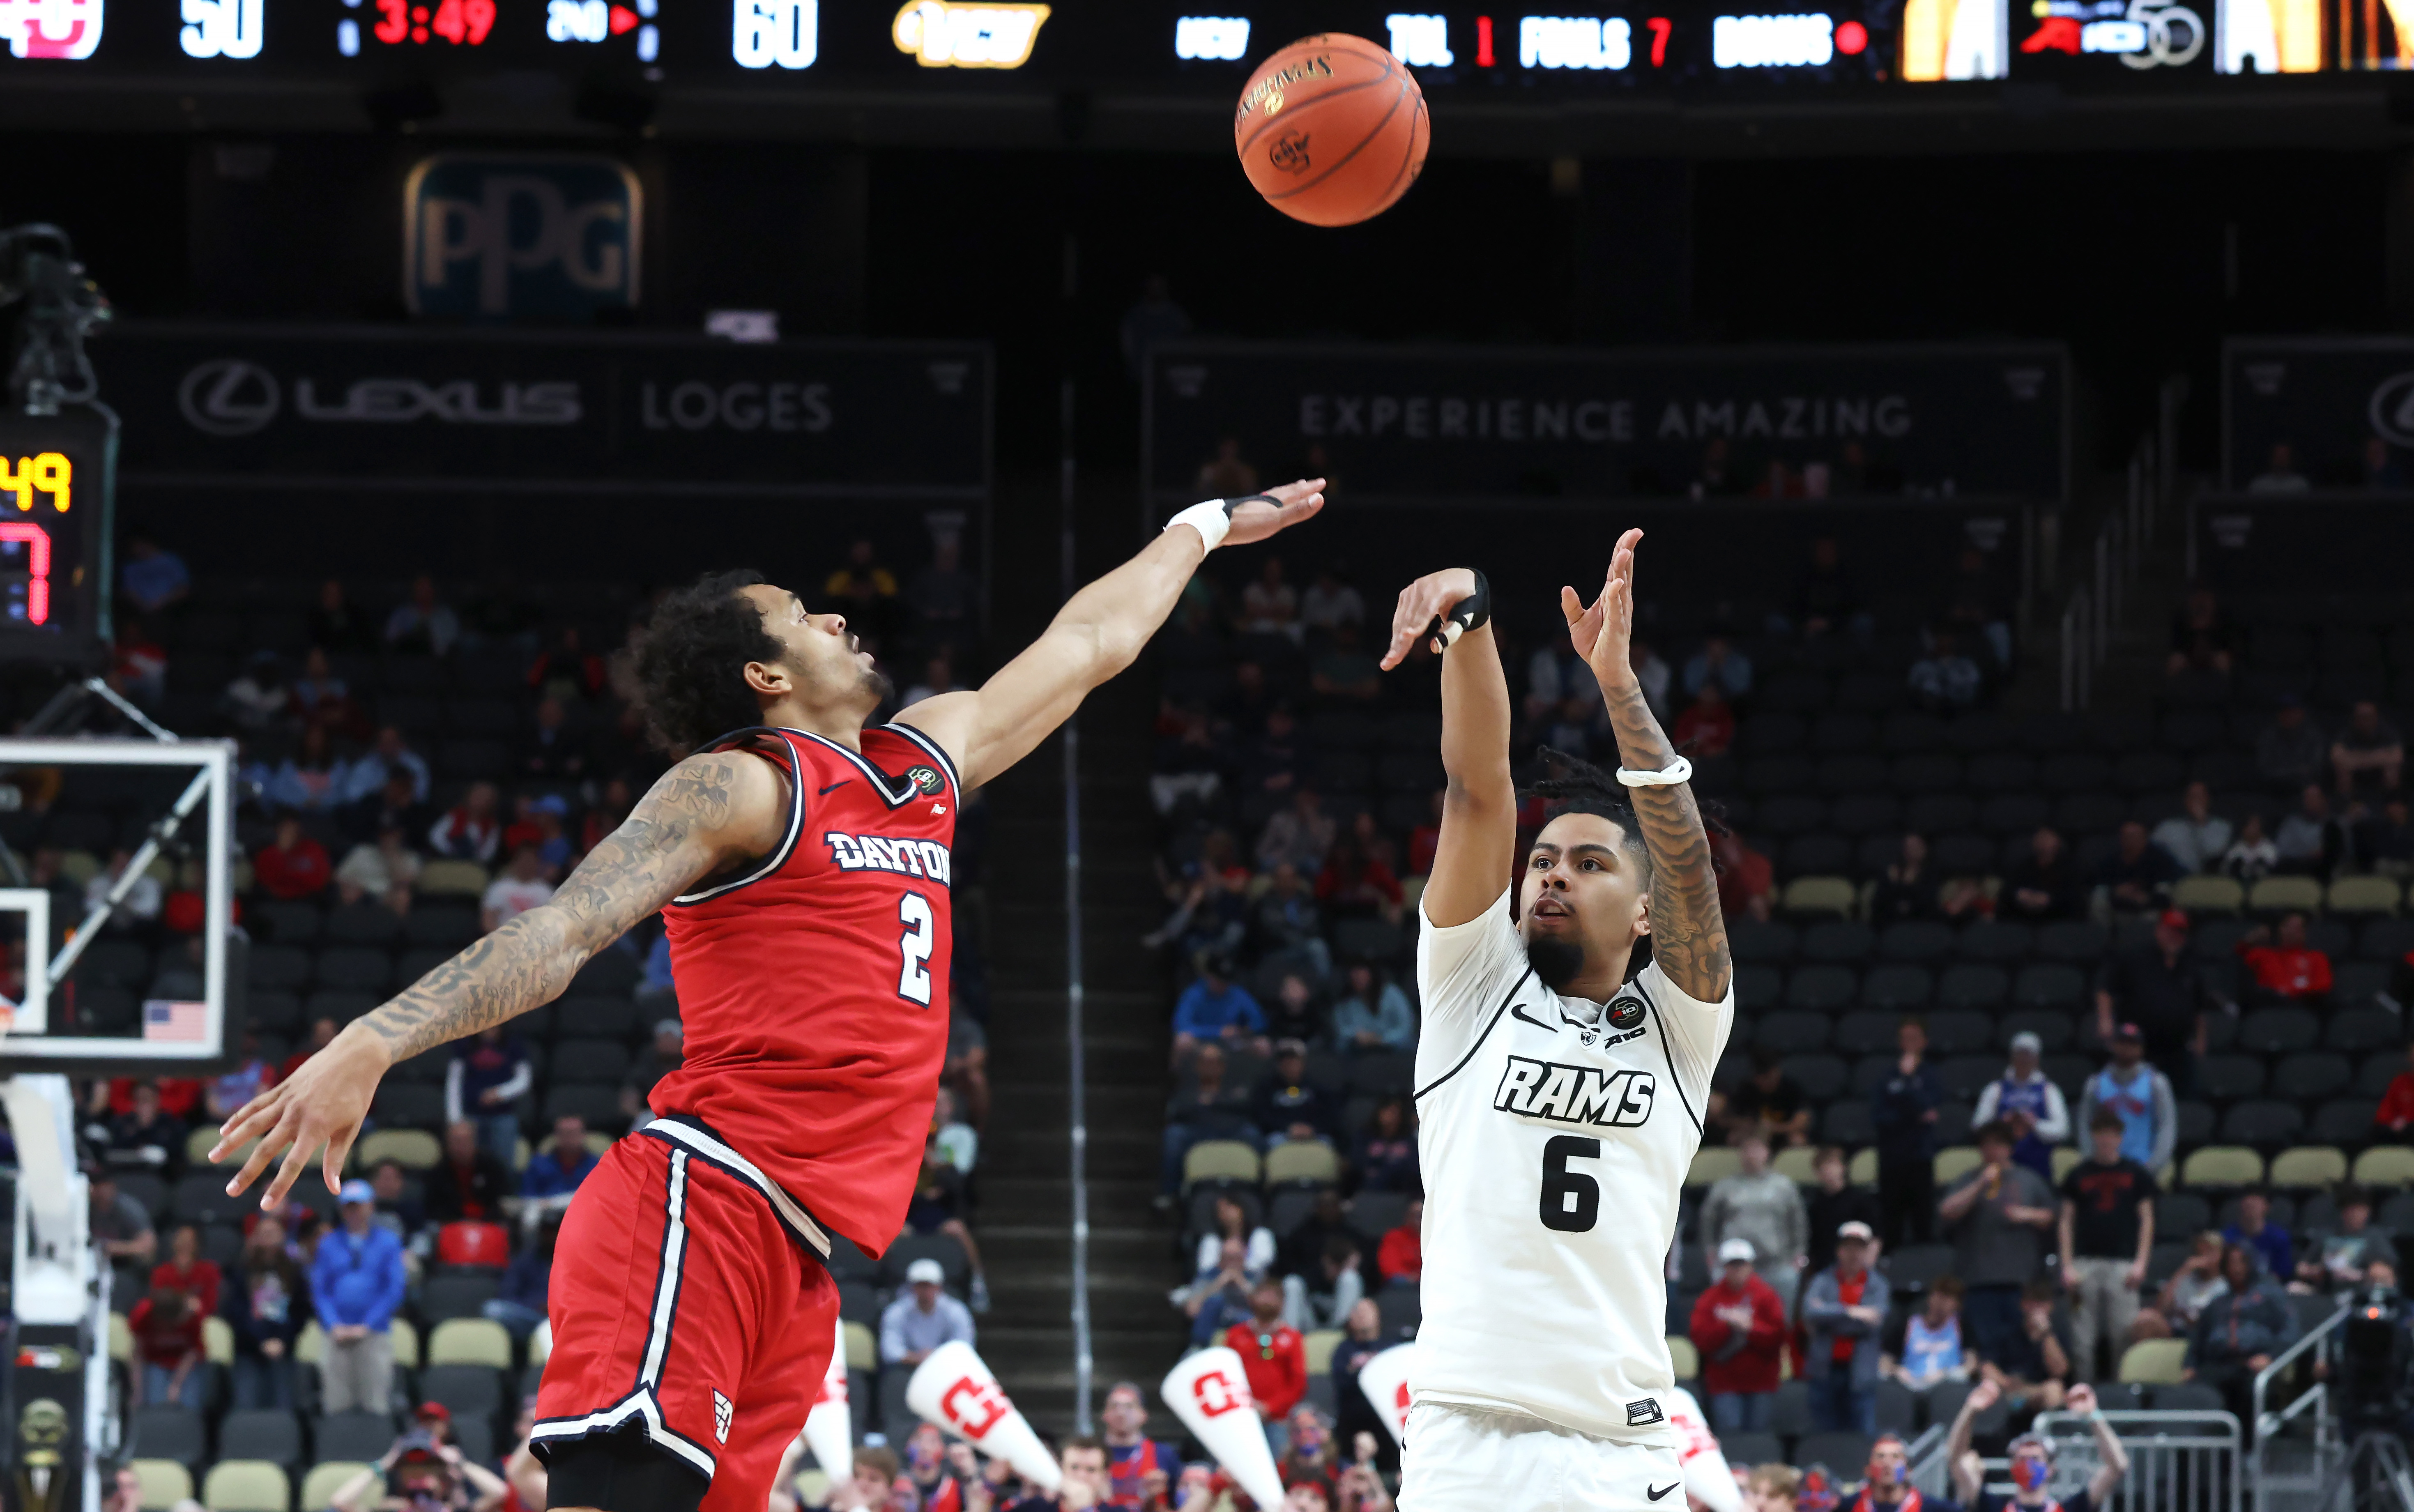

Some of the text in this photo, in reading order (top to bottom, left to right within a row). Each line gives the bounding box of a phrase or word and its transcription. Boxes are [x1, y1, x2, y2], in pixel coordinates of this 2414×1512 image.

[180, 0, 263, 58] 50
[374, 0, 496, 45] 3:49
[733, 0, 818, 69] 60
[1476, 16, 1496, 67] 1
[1519, 16, 1672, 69] FOULS 7
[421, 175, 623, 315] PPG
[293, 379, 833, 431] LEXUS LOGES
[1299, 395, 1912, 442] EXPERIENCE AMAZING
[0, 452, 72, 513] 49
[825, 832, 950, 888] DAYTON
[898, 889, 934, 1009] 2
[1604, 1027, 1646, 1050] A10
[1494, 1054, 1656, 1127] RAMS
[1539, 1135, 1601, 1233] 6
[1652, 1404, 1659, 1414] M
